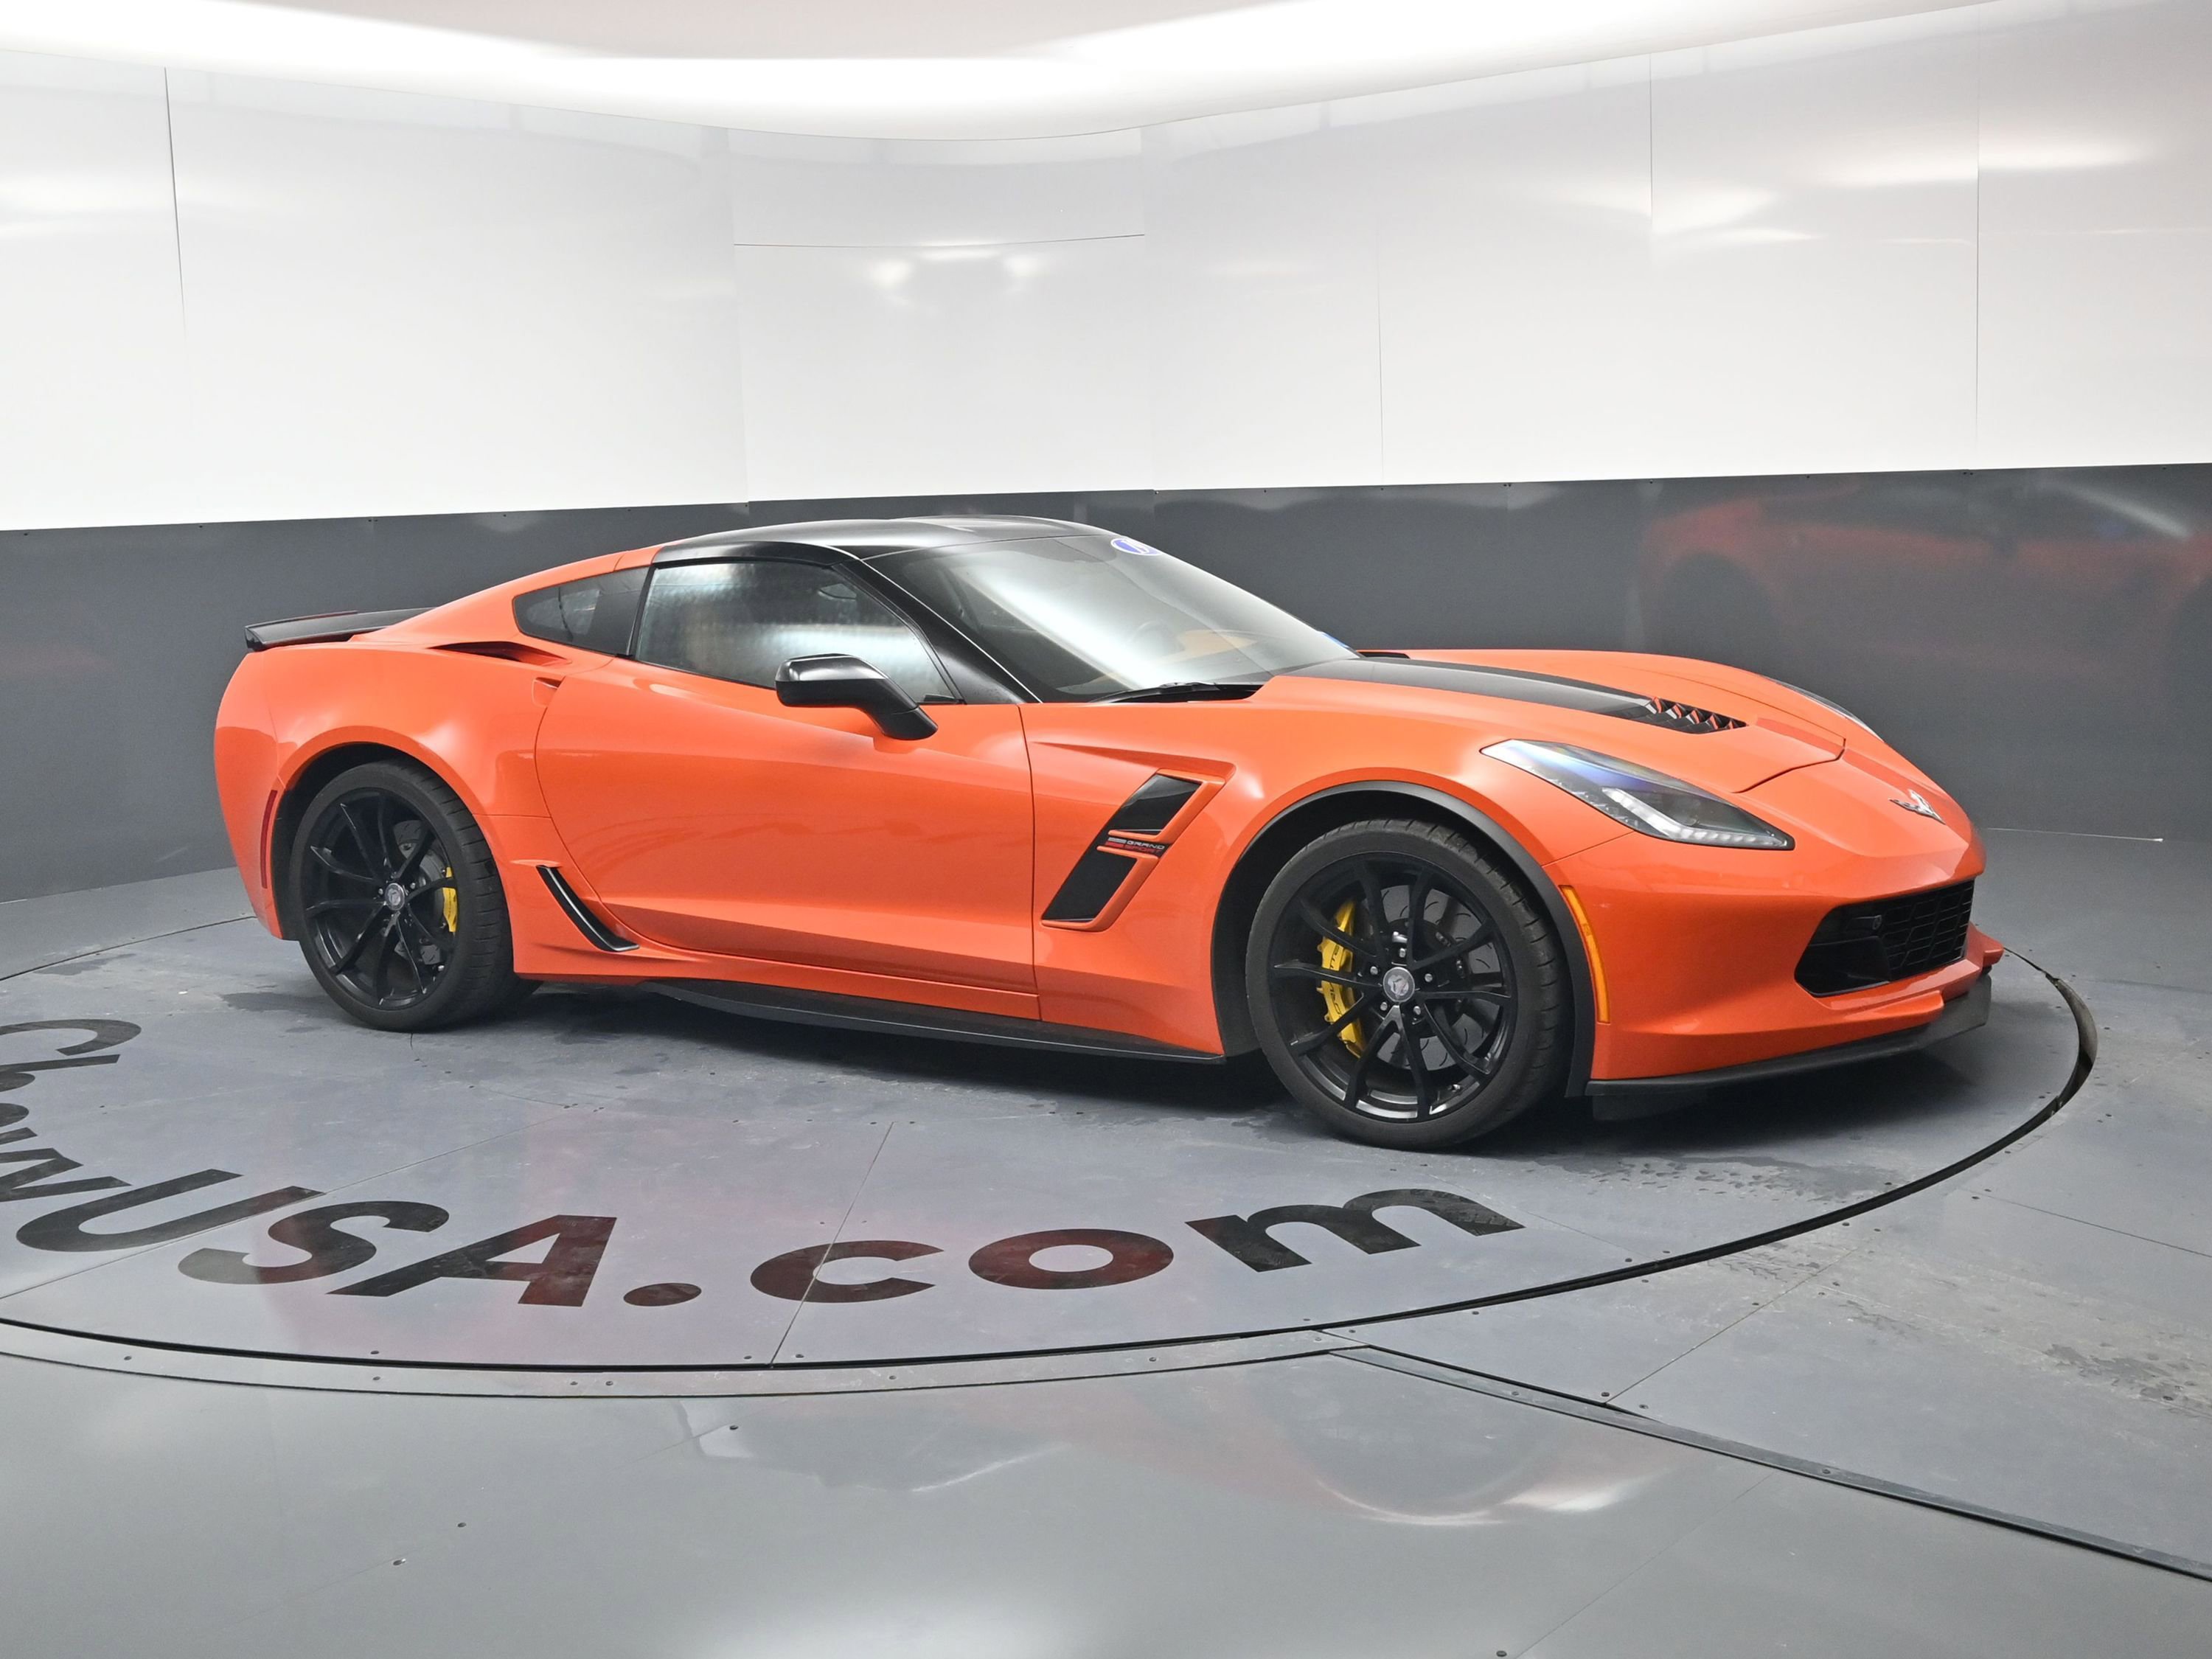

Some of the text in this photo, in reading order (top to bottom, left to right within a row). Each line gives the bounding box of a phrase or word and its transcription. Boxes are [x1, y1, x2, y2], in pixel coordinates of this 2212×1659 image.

[1124, 844, 1163, 854] SPORT
[1127, 841, 1166, 849] GRAND
[1330, 944, 1343, 1018] ORVTTE
[0, 1019, 1526, 1306] ChyUSA.com
